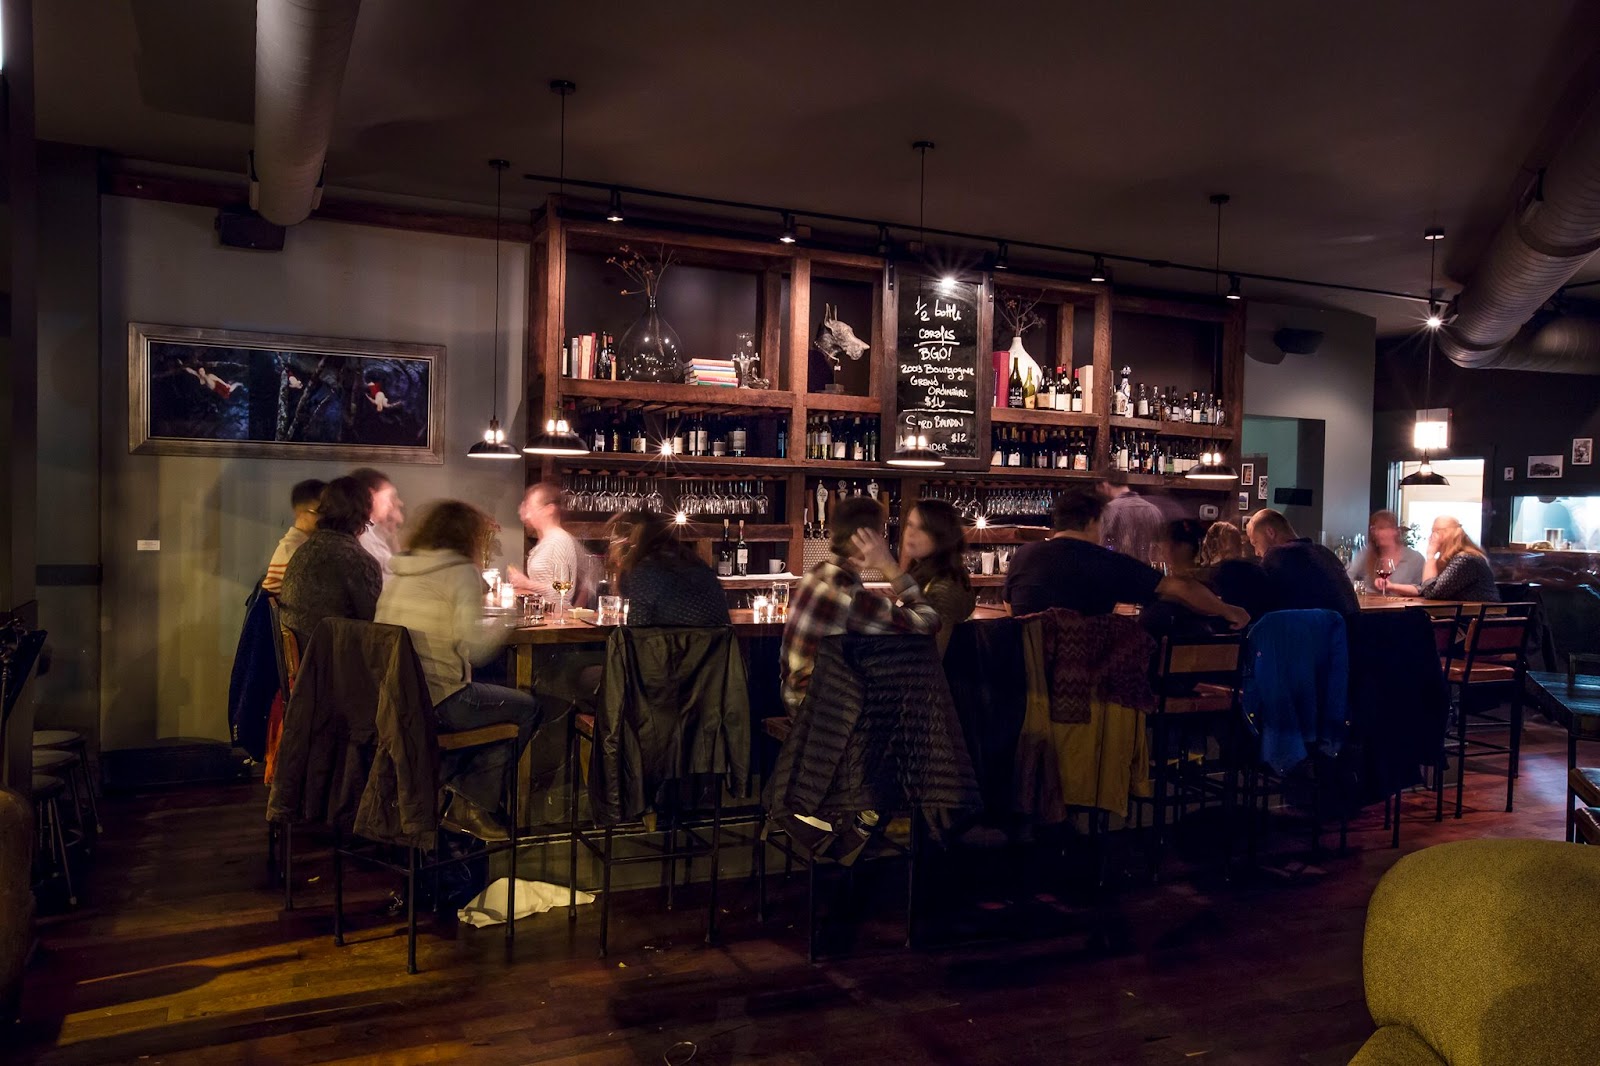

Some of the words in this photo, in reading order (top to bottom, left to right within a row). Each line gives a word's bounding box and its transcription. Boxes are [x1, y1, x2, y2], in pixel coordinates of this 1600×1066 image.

[934, 299, 962, 321] bottle
[923, 363, 975, 381] Bourgogne
[950, 433, 967, 443] $12
